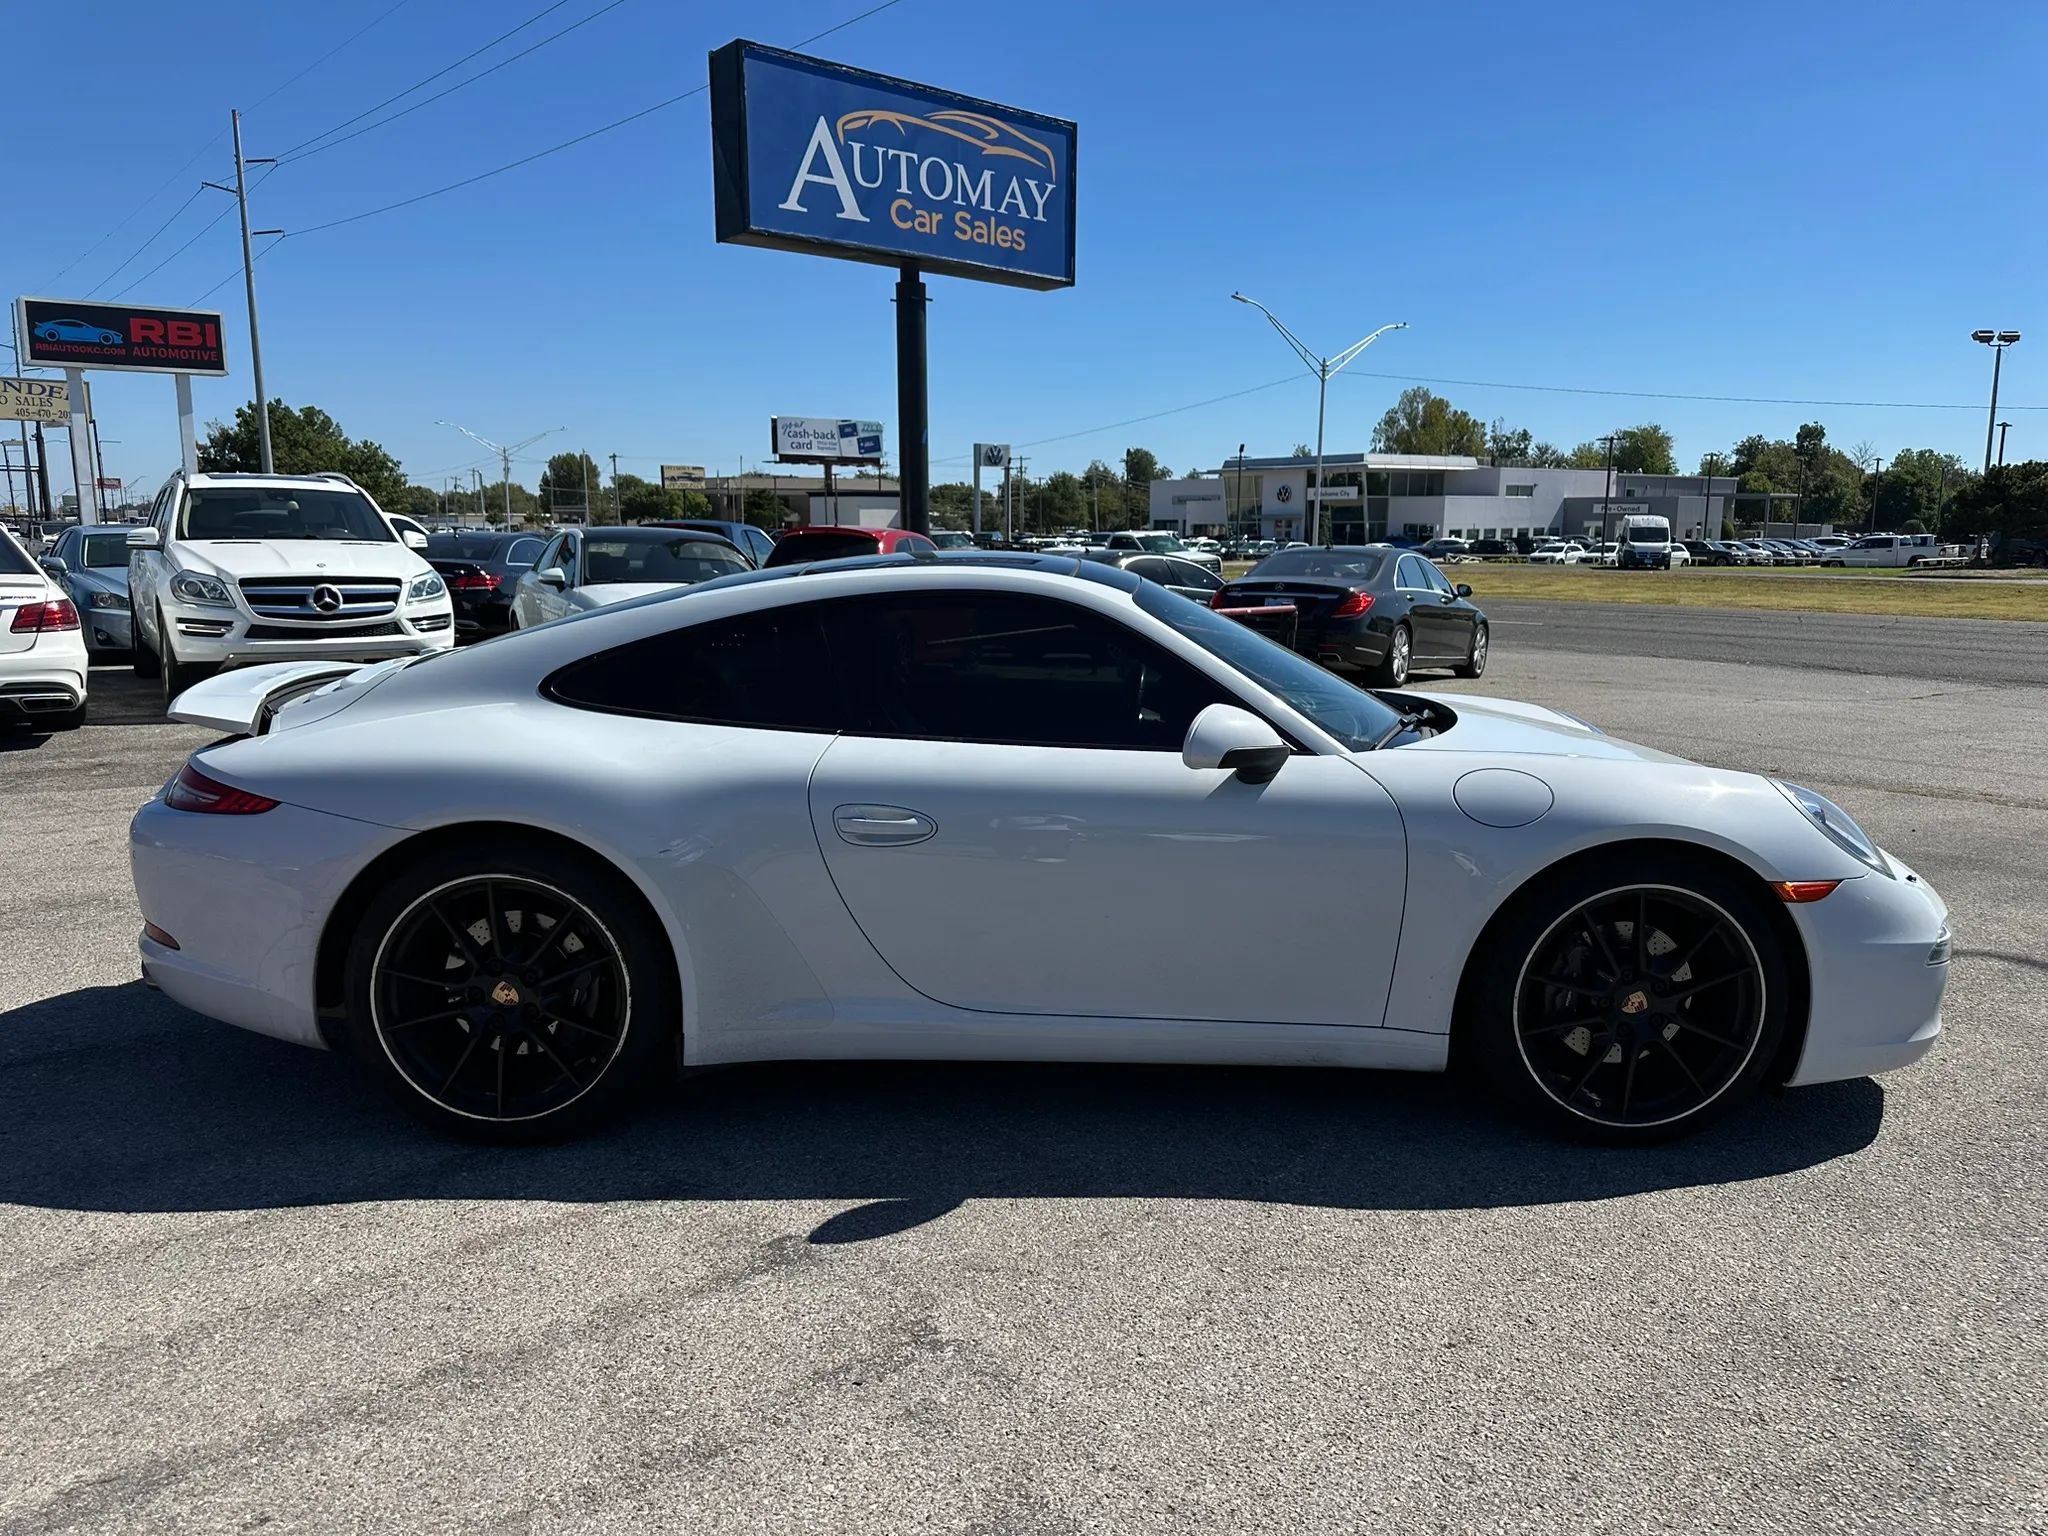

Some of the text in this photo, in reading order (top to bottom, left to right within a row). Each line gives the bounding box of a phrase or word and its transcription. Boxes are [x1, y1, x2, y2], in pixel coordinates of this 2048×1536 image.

[778, 114, 1056, 223] AUTOMAY
[890, 198, 1026, 252] Car Sales
[129, 317, 217, 348] RBI
[132, 346, 218, 361] AUTOMOTIVE
[2, 380, 69, 400] NDE
[15, 395, 53, 407] SALES
[787, 428, 836, 441] cash-back
[790, 439, 813, 450] card
